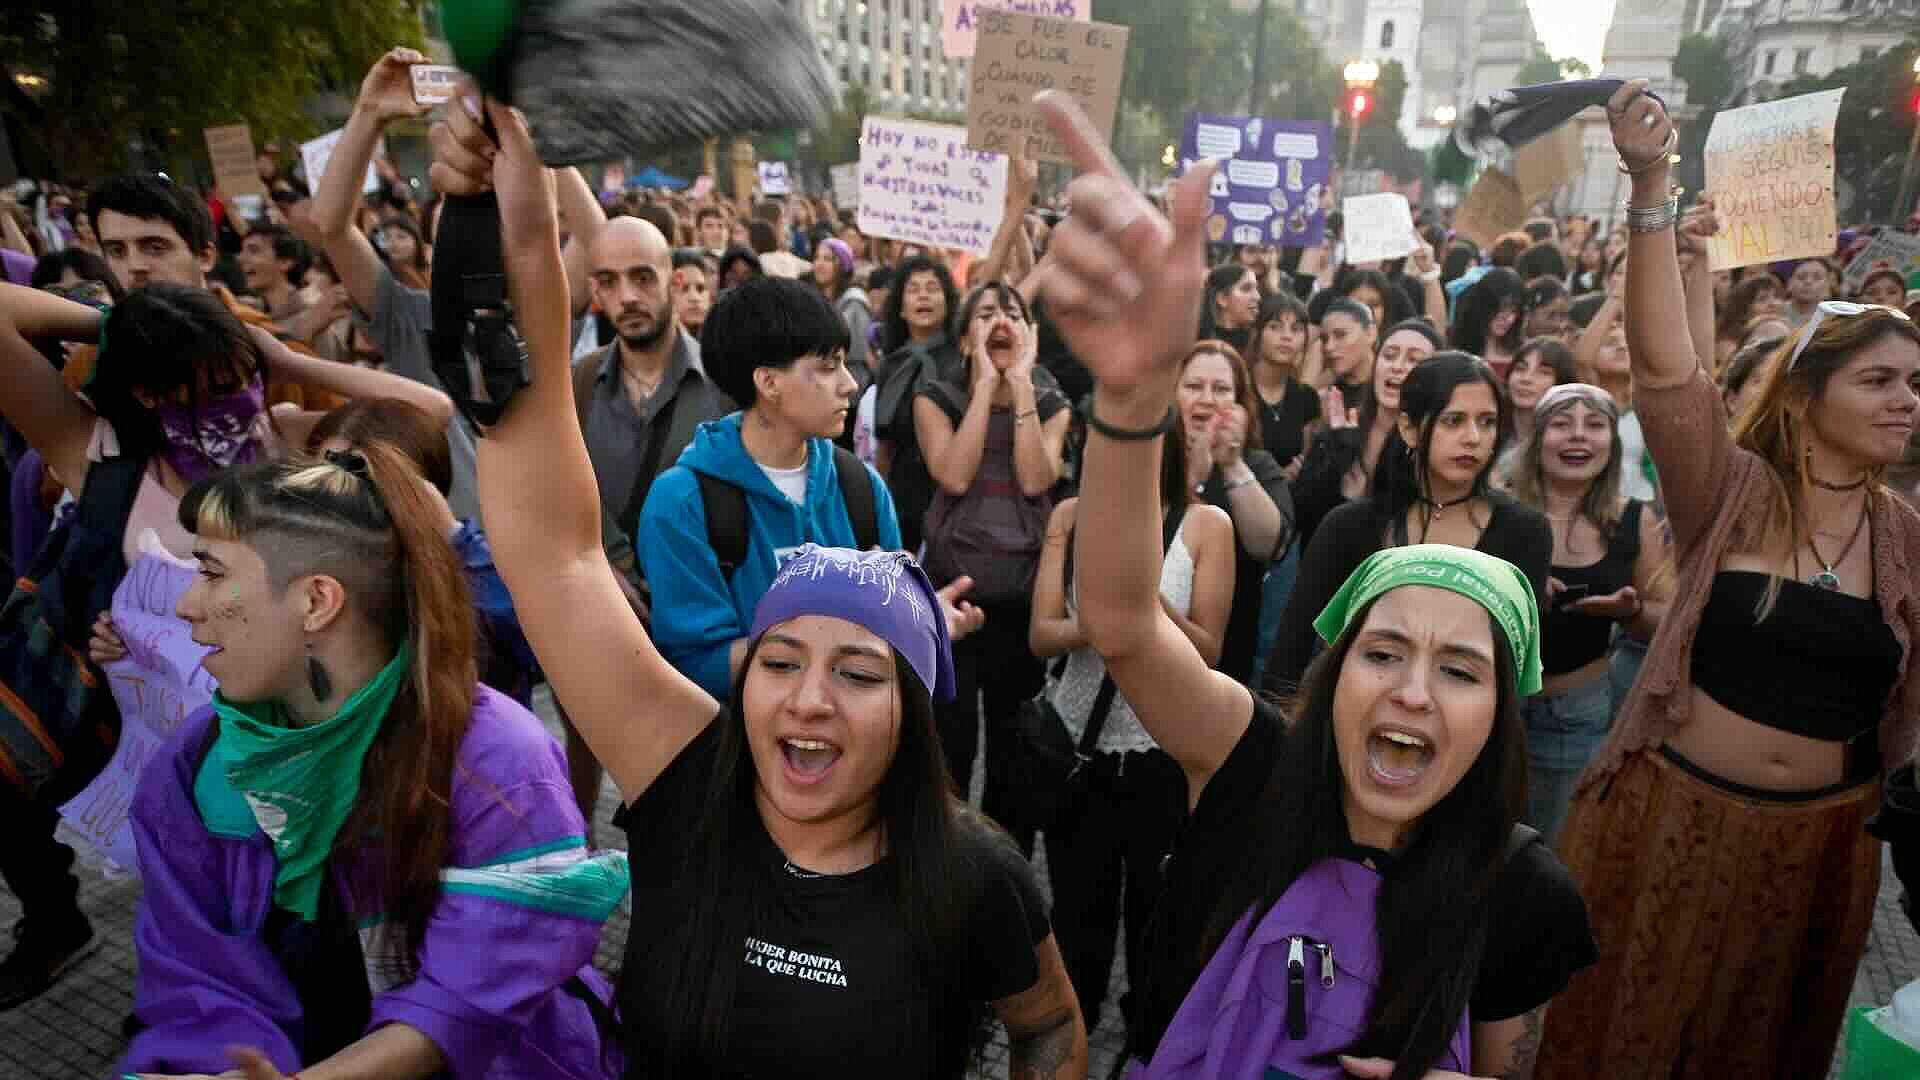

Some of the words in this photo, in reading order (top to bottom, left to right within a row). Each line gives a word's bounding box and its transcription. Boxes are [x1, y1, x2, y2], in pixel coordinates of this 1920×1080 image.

[1032, 18, 1067, 39] FUE
[1015, 39, 1071, 64] CALOR
[1067, 75, 1097, 96] SE
[977, 109, 1045, 134] GOBIE
[914, 135, 939, 153] NO
[984, 129, 1010, 150] DE
[1025, 136, 1066, 161] MIL
[788, 950, 842, 972] BONITA
[766, 959, 796, 974] QUE
[798, 967, 847, 987] LUCHA
